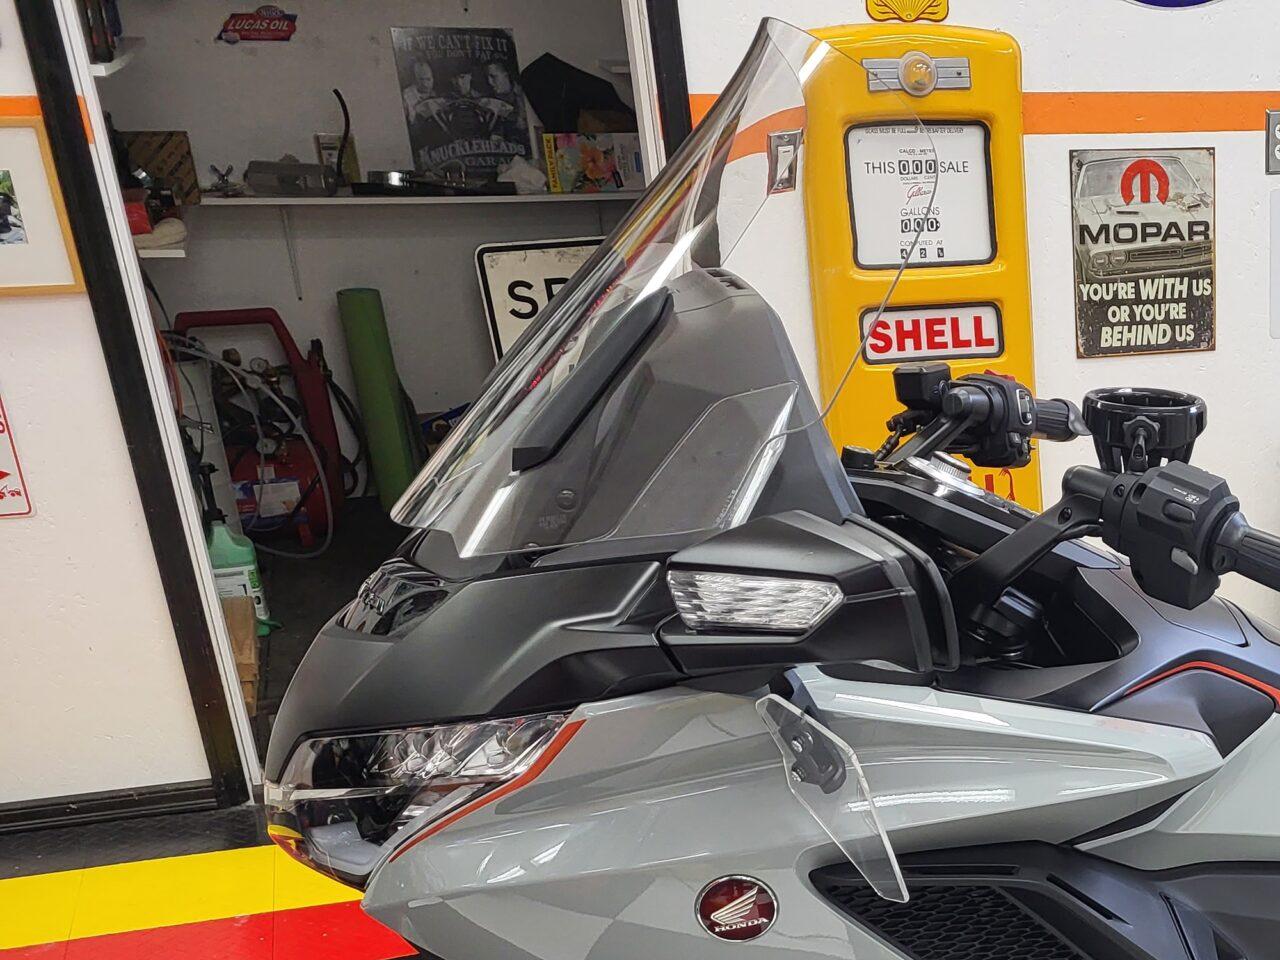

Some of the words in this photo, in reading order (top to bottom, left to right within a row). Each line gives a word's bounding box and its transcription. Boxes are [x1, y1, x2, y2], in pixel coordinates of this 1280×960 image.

[228, 19, 269, 30] LUCAS
[270, 20, 289, 30] OIL
[416, 35, 435, 49] WE
[438, 34, 471, 49] CAN'T
[474, 35, 494, 50] FIX
[496, 38, 508, 51] IT
[864, 162, 896, 174] THIS
[939, 161, 969, 173] SALE
[900, 206, 940, 216] GALLONS
[1079, 220, 1210, 245] MOPAR
[1079, 281, 1136, 301] YOU'RE
[1139, 276, 1189, 300] WITH
[1192, 278, 1212, 297] US
[1107, 305, 1131, 323] OR
[1132, 302, 1187, 322] YOU'RE
[868, 315, 995, 354] SHELL
[1100, 323, 1172, 348] BEHIND
[1175, 324, 1195, 342] US
[714, 917, 770, 933] HONDA
